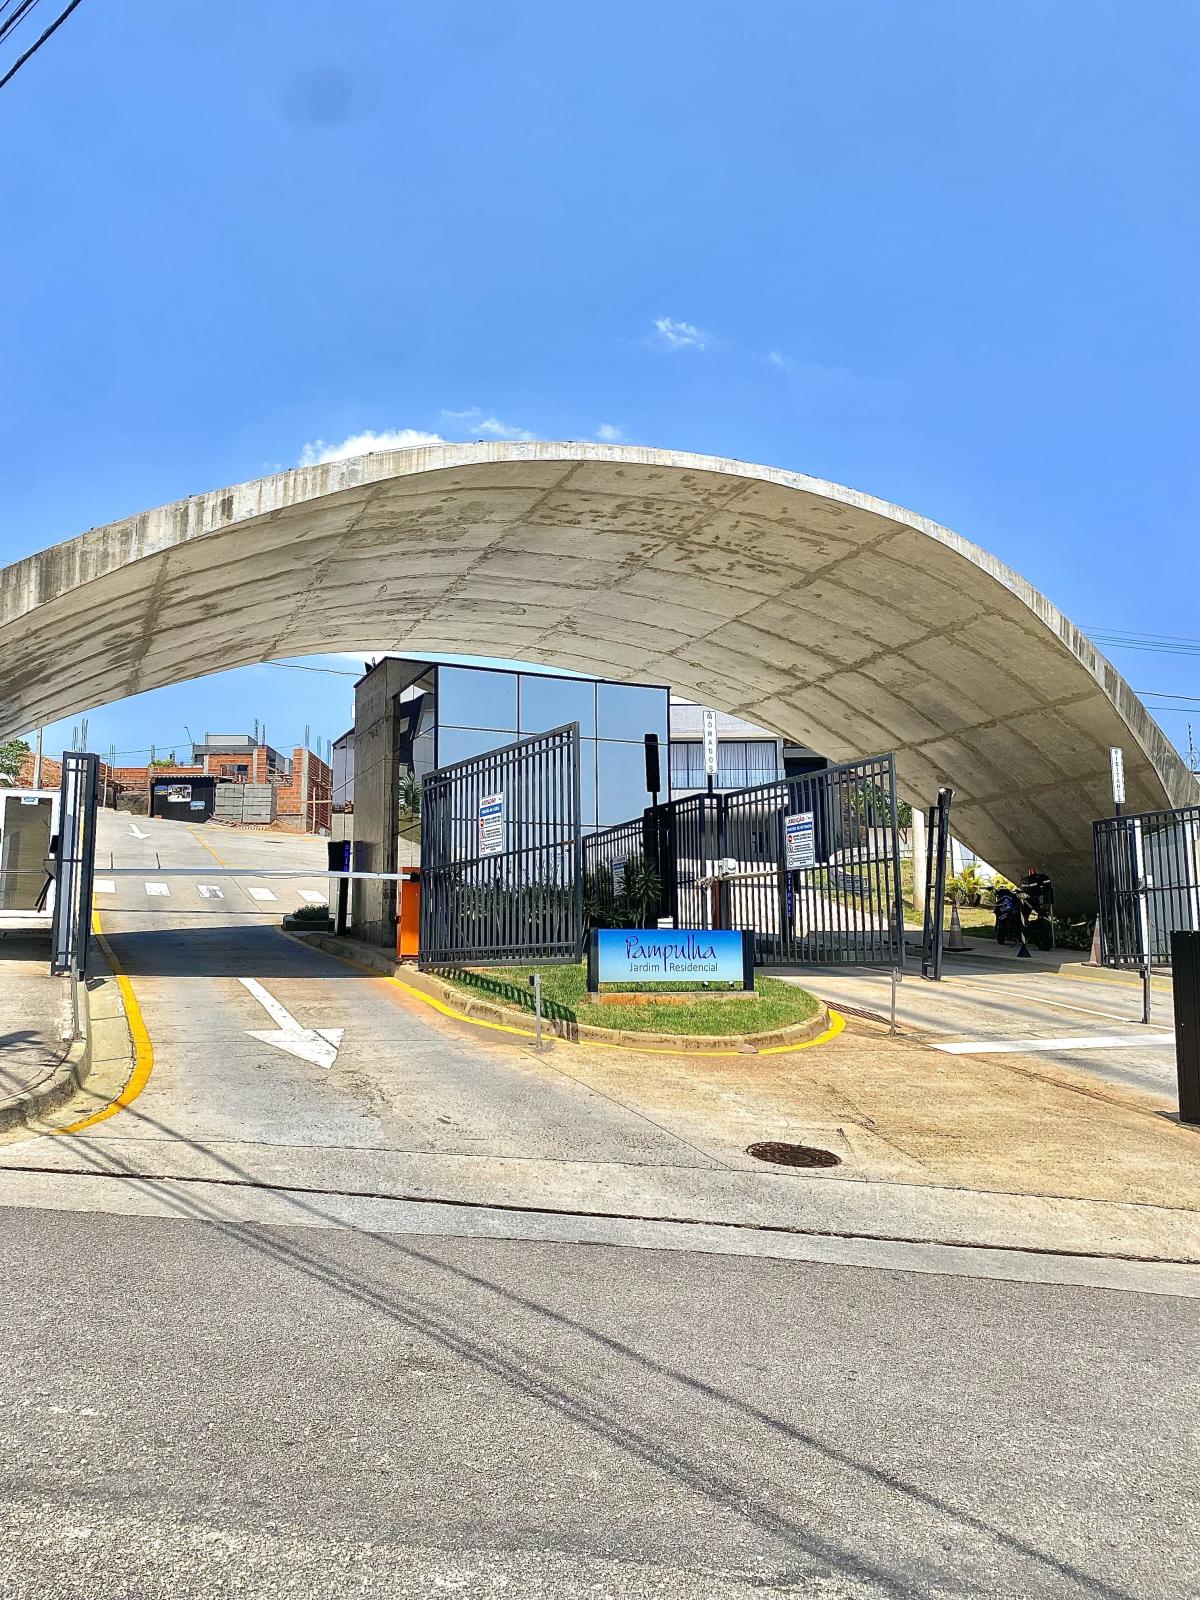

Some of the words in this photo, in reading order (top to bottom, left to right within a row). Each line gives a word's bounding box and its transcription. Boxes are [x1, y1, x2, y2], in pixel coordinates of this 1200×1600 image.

[625, 934, 717, 972] Pampulha
[629, 963, 660, 972] Jardim
[670, 963, 718, 972] Residencial
